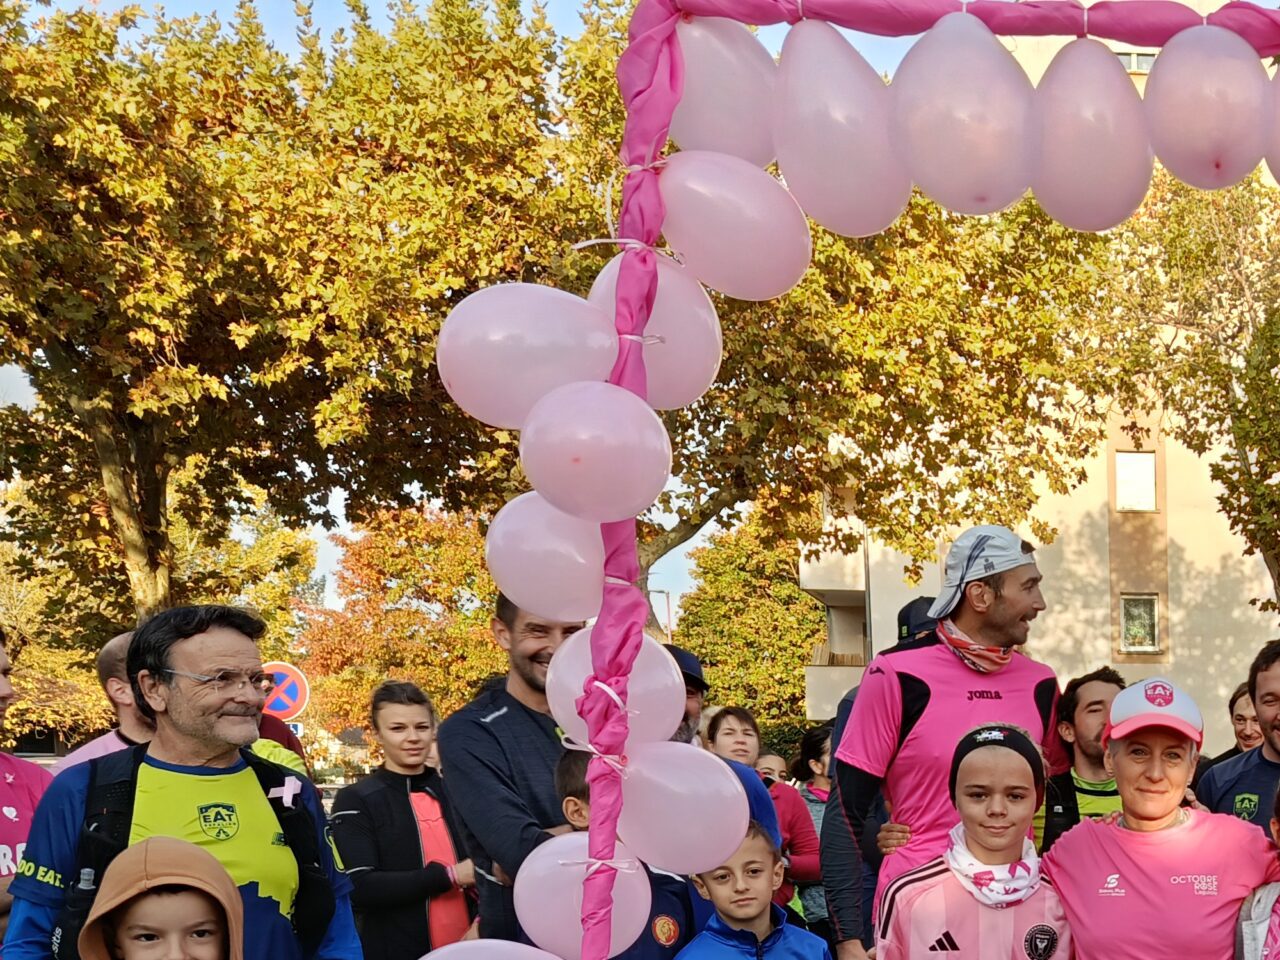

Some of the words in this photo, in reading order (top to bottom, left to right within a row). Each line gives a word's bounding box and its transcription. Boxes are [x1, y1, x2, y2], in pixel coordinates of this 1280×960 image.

[1147, 686, 1171, 695] EAT
[1236, 799, 1256, 809] EAT
[202, 810, 234, 823] EAT
[17, 859, 36, 876] DO
[1170, 874, 1218, 884] OCTOBRE
[1194, 882, 1218, 891] ROSE
